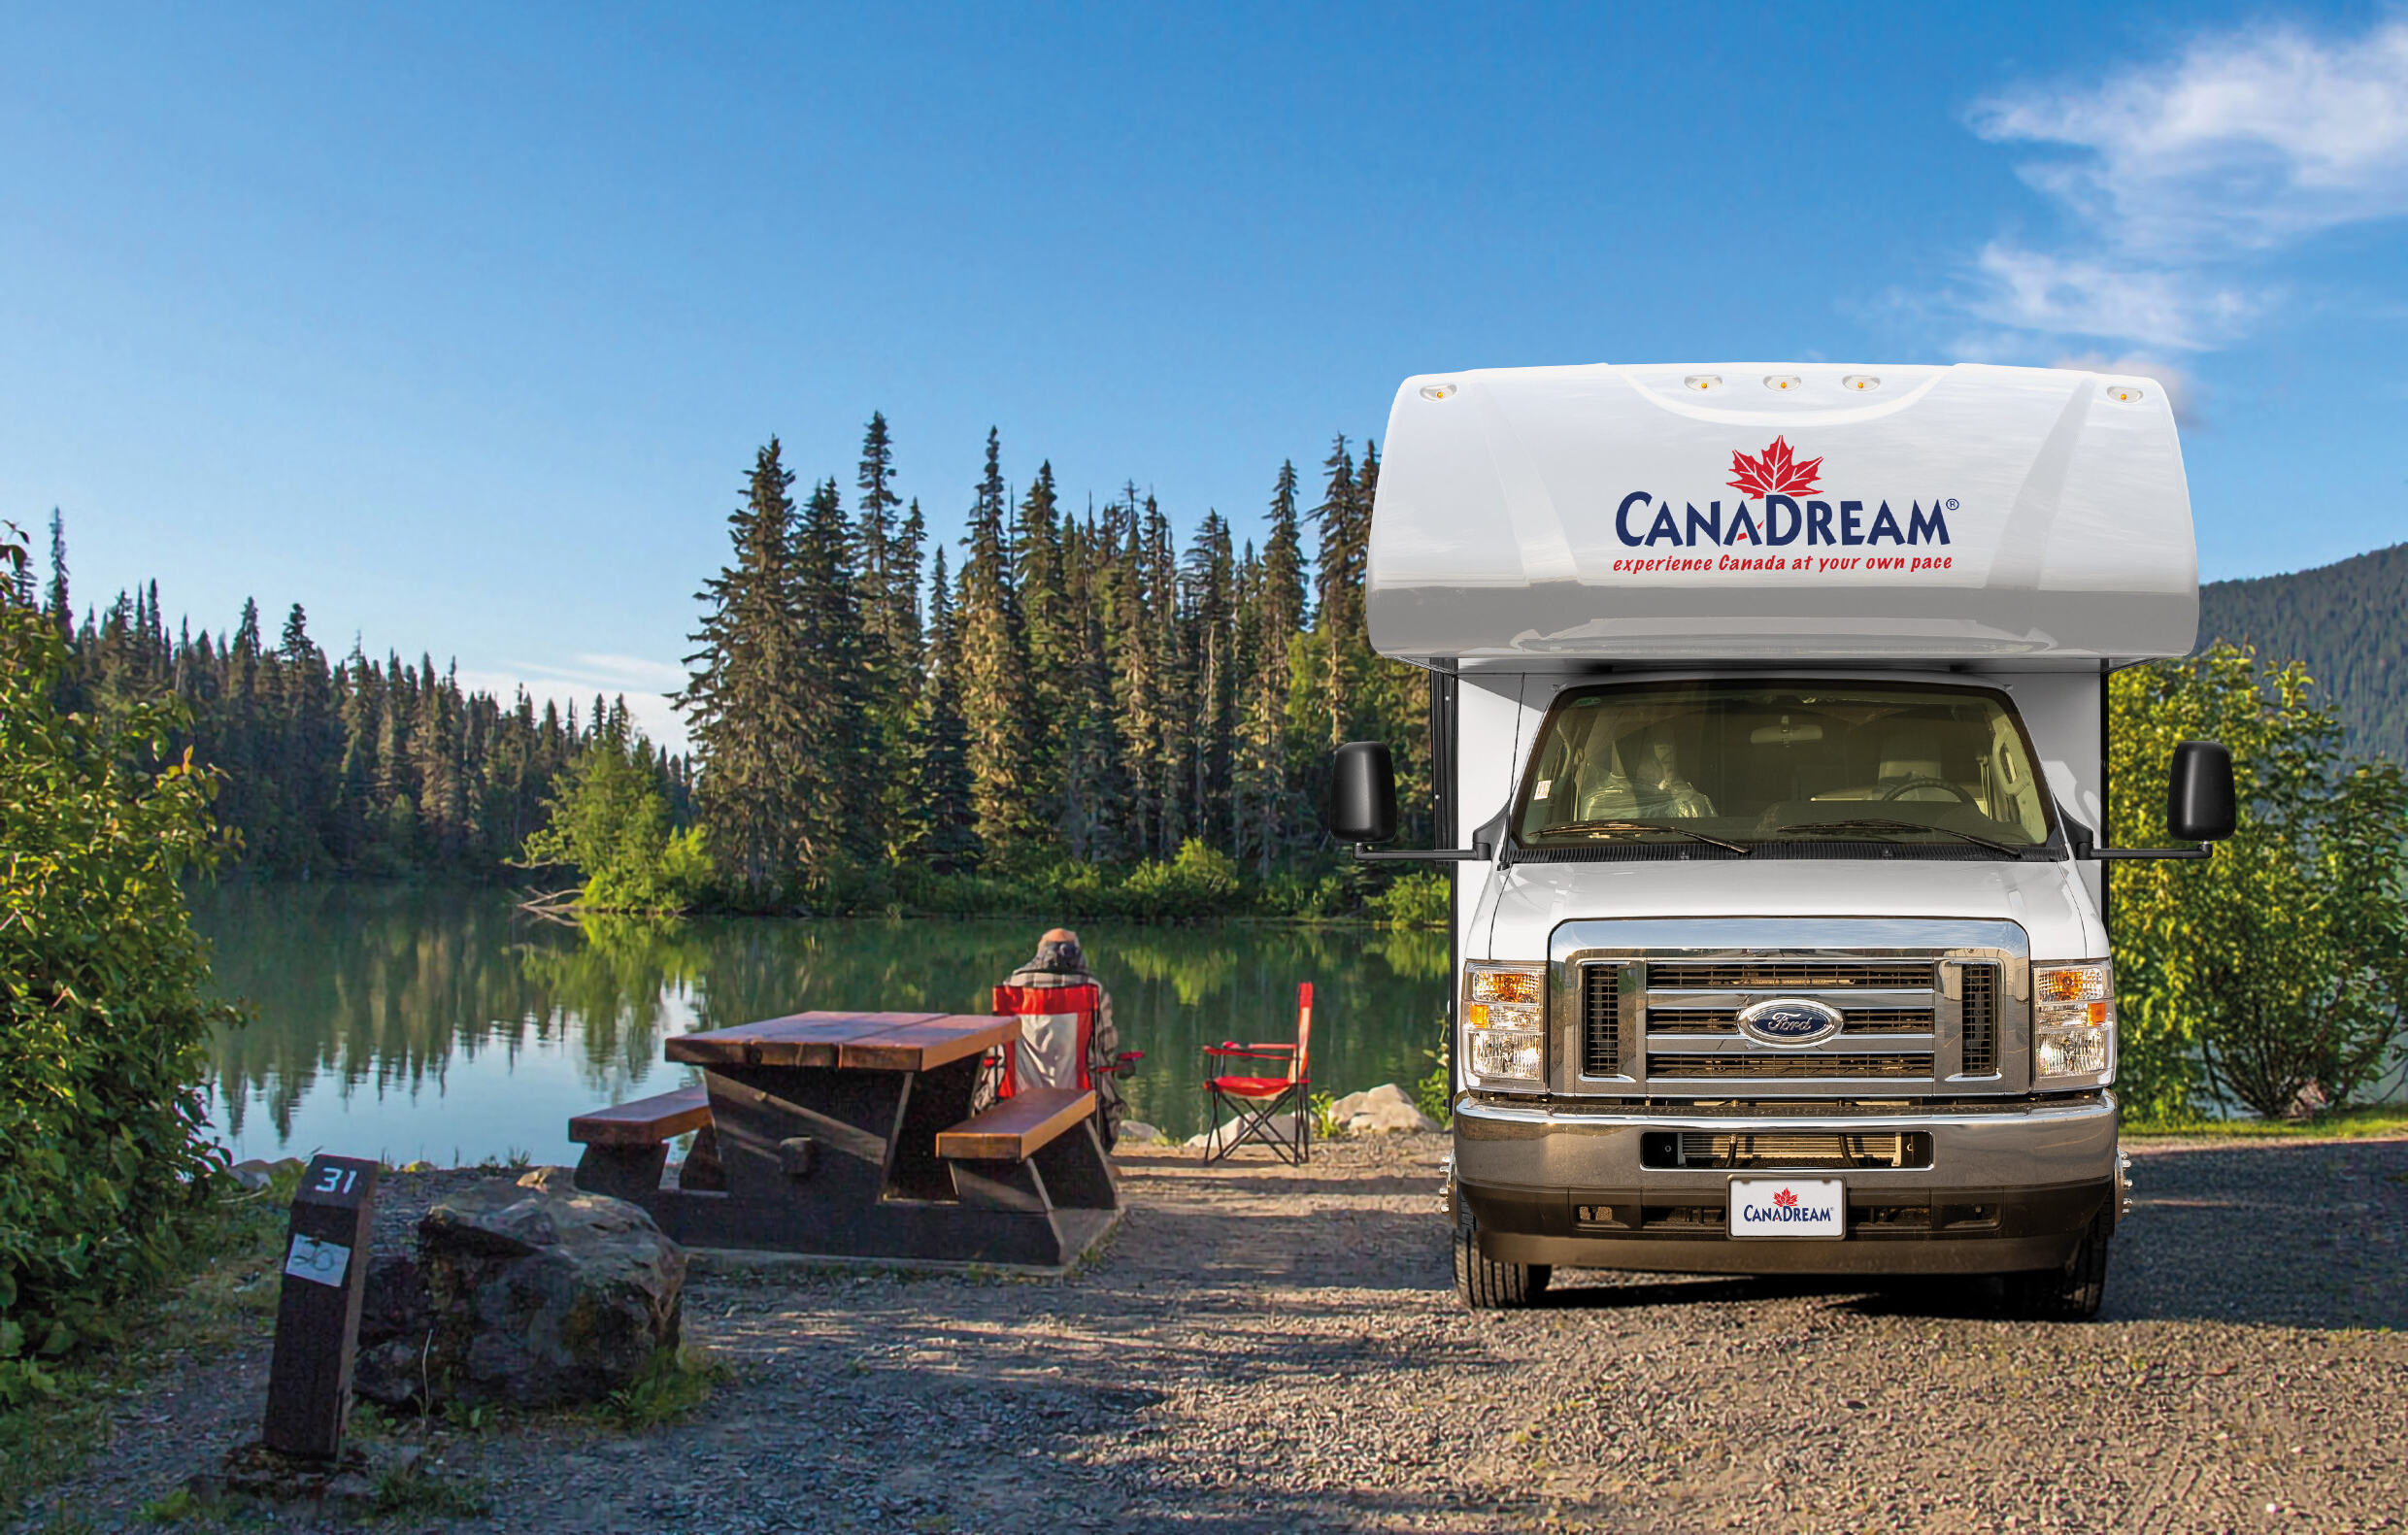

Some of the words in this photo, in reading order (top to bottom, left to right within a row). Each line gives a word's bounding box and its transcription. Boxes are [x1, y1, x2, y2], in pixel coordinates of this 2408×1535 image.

[1613, 555, 1712, 574] experience
[1718, 554, 1786, 571] Canada
[1791, 555, 1814, 571] at
[1819, 556, 1861, 573] your
[1865, 556, 1905, 570] own
[1910, 556, 1953, 572] pace
[1767, 1012, 1813, 1031] Ford
[315, 1167, 357, 1195] 31
